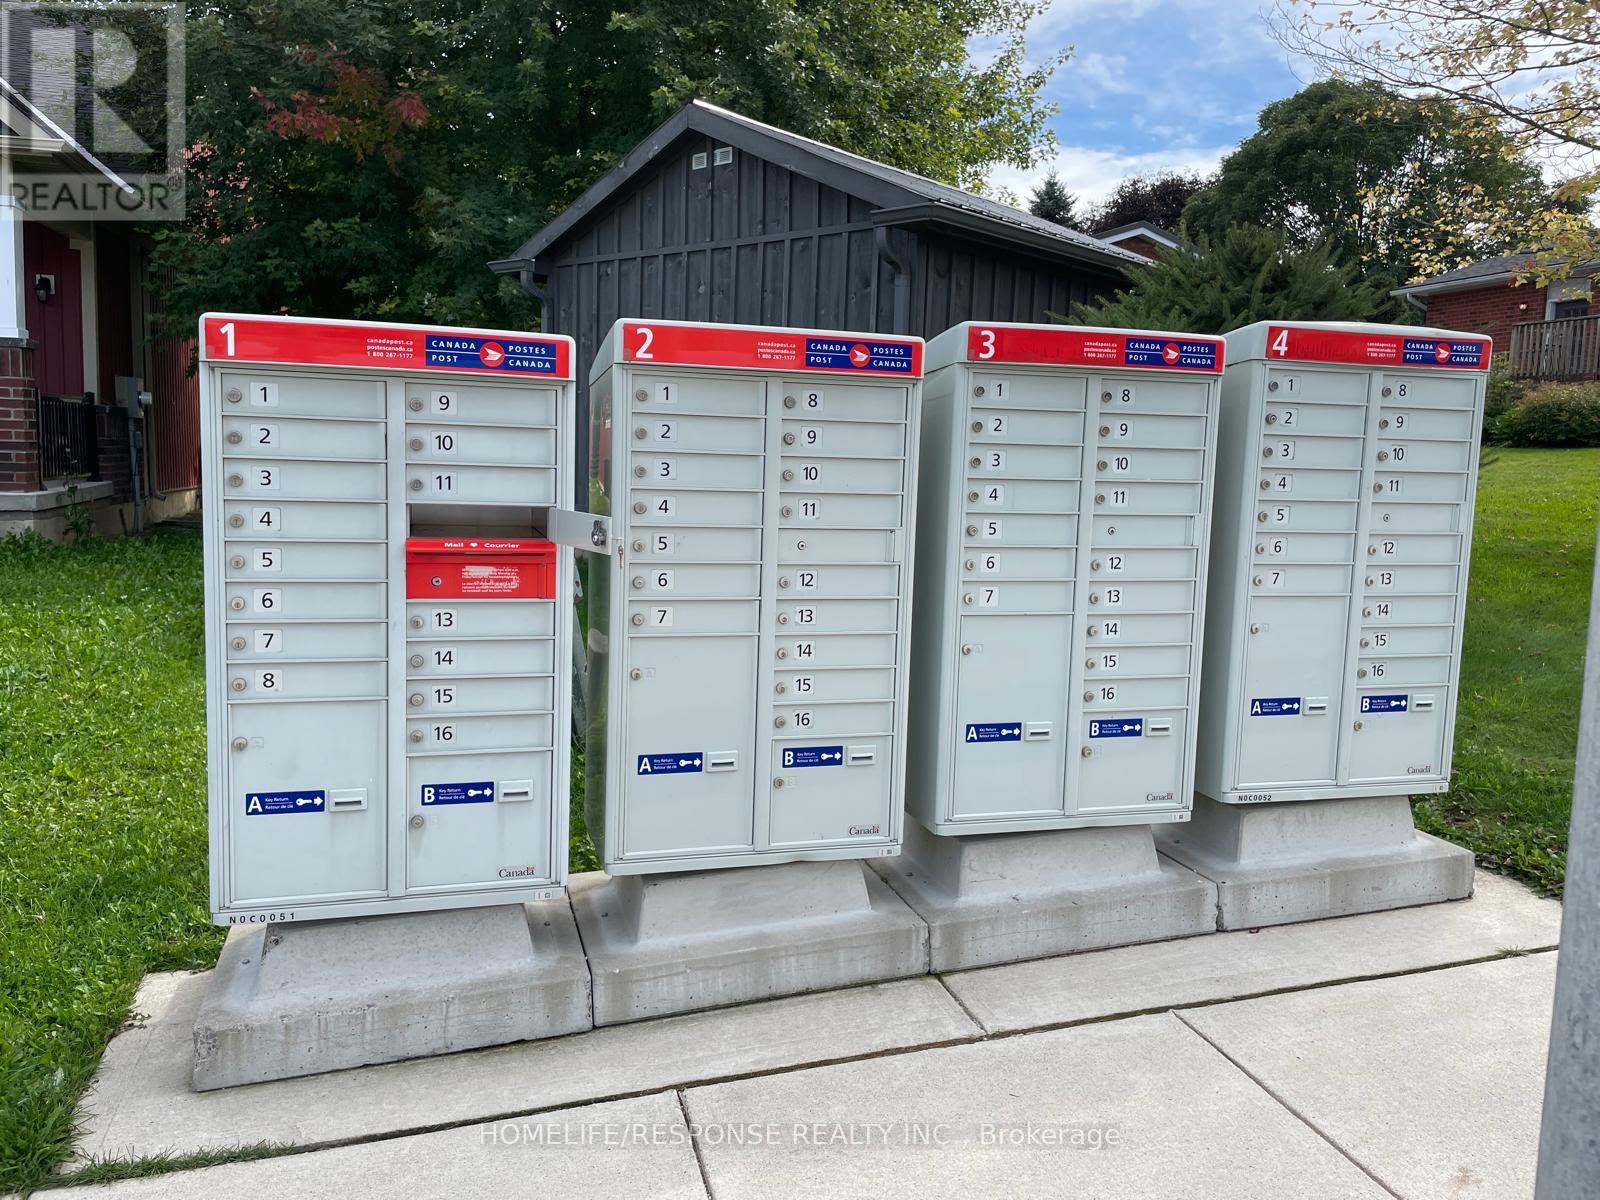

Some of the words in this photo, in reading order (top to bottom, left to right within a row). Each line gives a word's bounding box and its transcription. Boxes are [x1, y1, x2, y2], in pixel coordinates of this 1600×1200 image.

[219, 322, 237, 357] 1
[431, 340, 476, 350] CANADA
[635, 328, 654, 359] 2
[978, 330, 996, 360] 3
[1129, 342, 1161, 350] CANADA
[1272, 329, 1289, 356] 4
[1406, 342, 1434, 350] CANADA
[508, 345, 547, 354] POSTES
[810, 342, 848, 352] CANADA
[873, 346, 904, 356] POSTES
[431, 354, 459, 364] POST
[508, 359, 552, 369] CANADA
[810, 356, 832, 364] POST
[873, 360, 908, 368] CANADA
[1128, 353, 1148, 361] POST
[1182, 357, 1212, 365] CANADA
[996, 383, 1003, 397] 1
[1288, 378, 1294, 392] 1
[1398, 383, 1407, 397] 8
[260, 386, 268, 403] 1
[663, 386, 669, 401] 1
[807, 393, 818, 408] 8
[1121, 388, 1131, 403] 8
[438, 395, 450, 411] 9
[993, 418, 1002, 432] 2
[1284, 411, 1293, 425] 2
[1396, 415, 1404, 429] 9
[259, 427, 271, 444] 2
[660, 424, 671, 439] 2
[1119, 422, 1128, 437] 9
[434, 434, 454, 451] 10
[807, 429, 817, 445] 9
[1281, 443, 1290, 457] 3
[1392, 447, 1405, 461] 10
[991, 453, 1001, 467] 3
[1115, 456, 1129, 471] 10
[660, 461, 670, 477] 3
[803, 466, 818, 481] 10
[260, 469, 272, 486] 3
[435, 475, 451, 491] 11
[1278, 476, 1287, 489] 4
[1389, 479, 1399, 492] 11
[988, 487, 998, 502] 4
[1113, 490, 1125, 504] 11
[658, 499, 670, 514] 4
[802, 502, 816, 517] 11
[259, 511, 273, 527] 4
[1276, 508, 1285, 522] 5
[988, 522, 997, 536] 5
[658, 536, 668, 551] 5
[1274, 540, 1282, 554] 6
[1383, 541, 1395, 554] 12
[262, 551, 273, 568] 5
[986, 555, 995, 570] 6
[1108, 556, 1122, 570] 12
[658, 572, 668, 587] 6
[799, 573, 814, 587] 12
[1272, 572, 1280, 585] 7
[1380, 572, 1392, 585] 13
[261, 592, 274, 609] 6
[985, 589, 994, 604] 7
[1106, 589, 1120, 603] 13
[657, 609, 667, 624] 7
[798, 608, 813, 623] 13
[1377, 603, 1389, 616] 14
[435, 612, 453, 627] 13
[1104, 622, 1118, 636] 14
[262, 633, 274, 649] 7
[1375, 634, 1387, 647] 15
[796, 643, 813, 658] 14
[434, 650, 454, 666] 14
[1103, 654, 1117, 668] 15
[1371, 664, 1384, 677] 16
[262, 672, 275, 689] 8
[795, 678, 811, 692] 15
[434, 688, 453, 704] 15
[1100, 687, 1115, 700] 16
[1252, 700, 1262, 715] A
[1362, 698, 1370, 711] B
[794, 712, 811, 727] 16
[434, 725, 453, 741] 16
[967, 726, 978, 741] A
[1091, 722, 1100, 736] B
[639, 757, 652, 773] A
[784, 751, 794, 766] B
[1407, 766, 1431, 774] Canada
[424, 787, 435, 803] B
[1146, 793, 1173, 801] Canada
[248, 796, 263, 813] A
[848, 826, 880, 836] Canada
[498, 866, 534, 879] Canada
